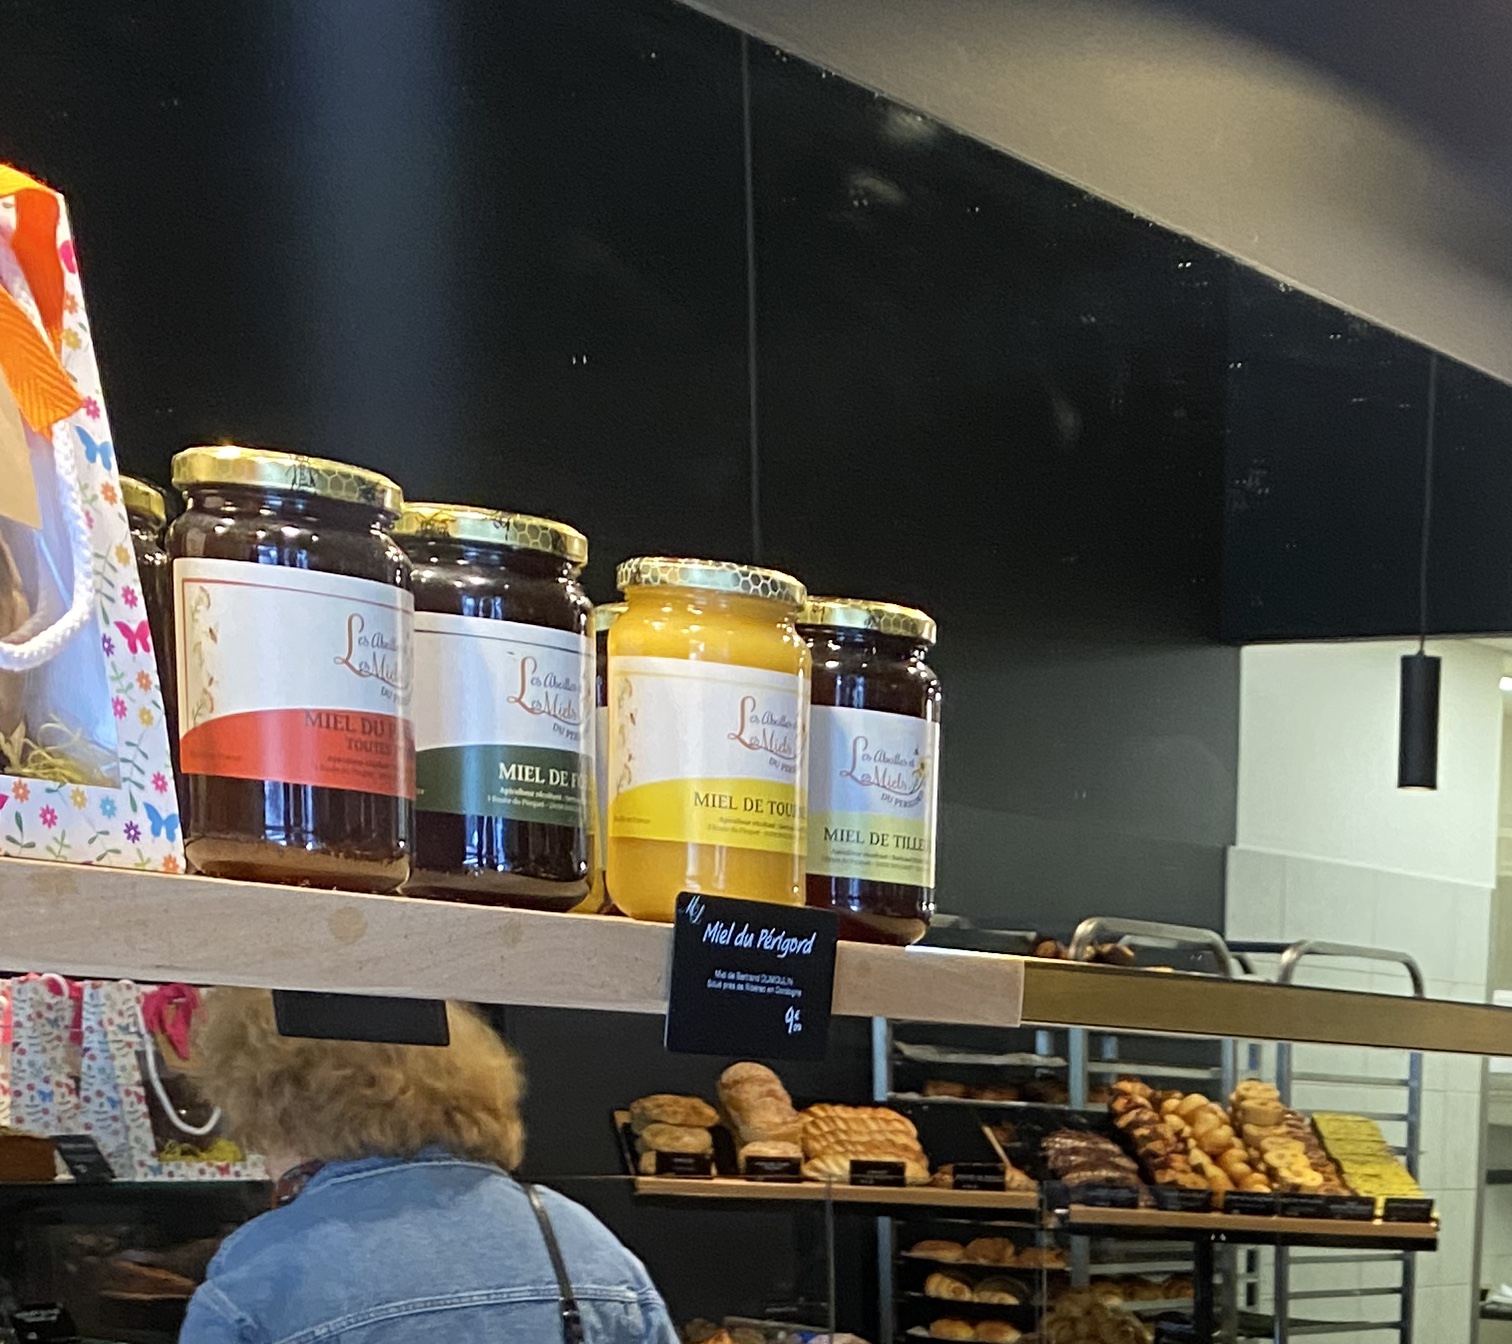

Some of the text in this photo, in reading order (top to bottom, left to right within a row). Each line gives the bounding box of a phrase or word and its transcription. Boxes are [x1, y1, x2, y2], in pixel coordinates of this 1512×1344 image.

[304, 709, 356, 733] MIEL
[361, 719, 386, 738] DU
[499, 762, 545, 784] MIEL
[549, 769, 568, 787] DE
[694, 791, 738, 810] MIEL
[743, 797, 764, 813] DE
[823, 826, 864, 845] MIEL
[869, 832, 889, 847] DE
[703, 921, 817, 958] Miel du Périgord
